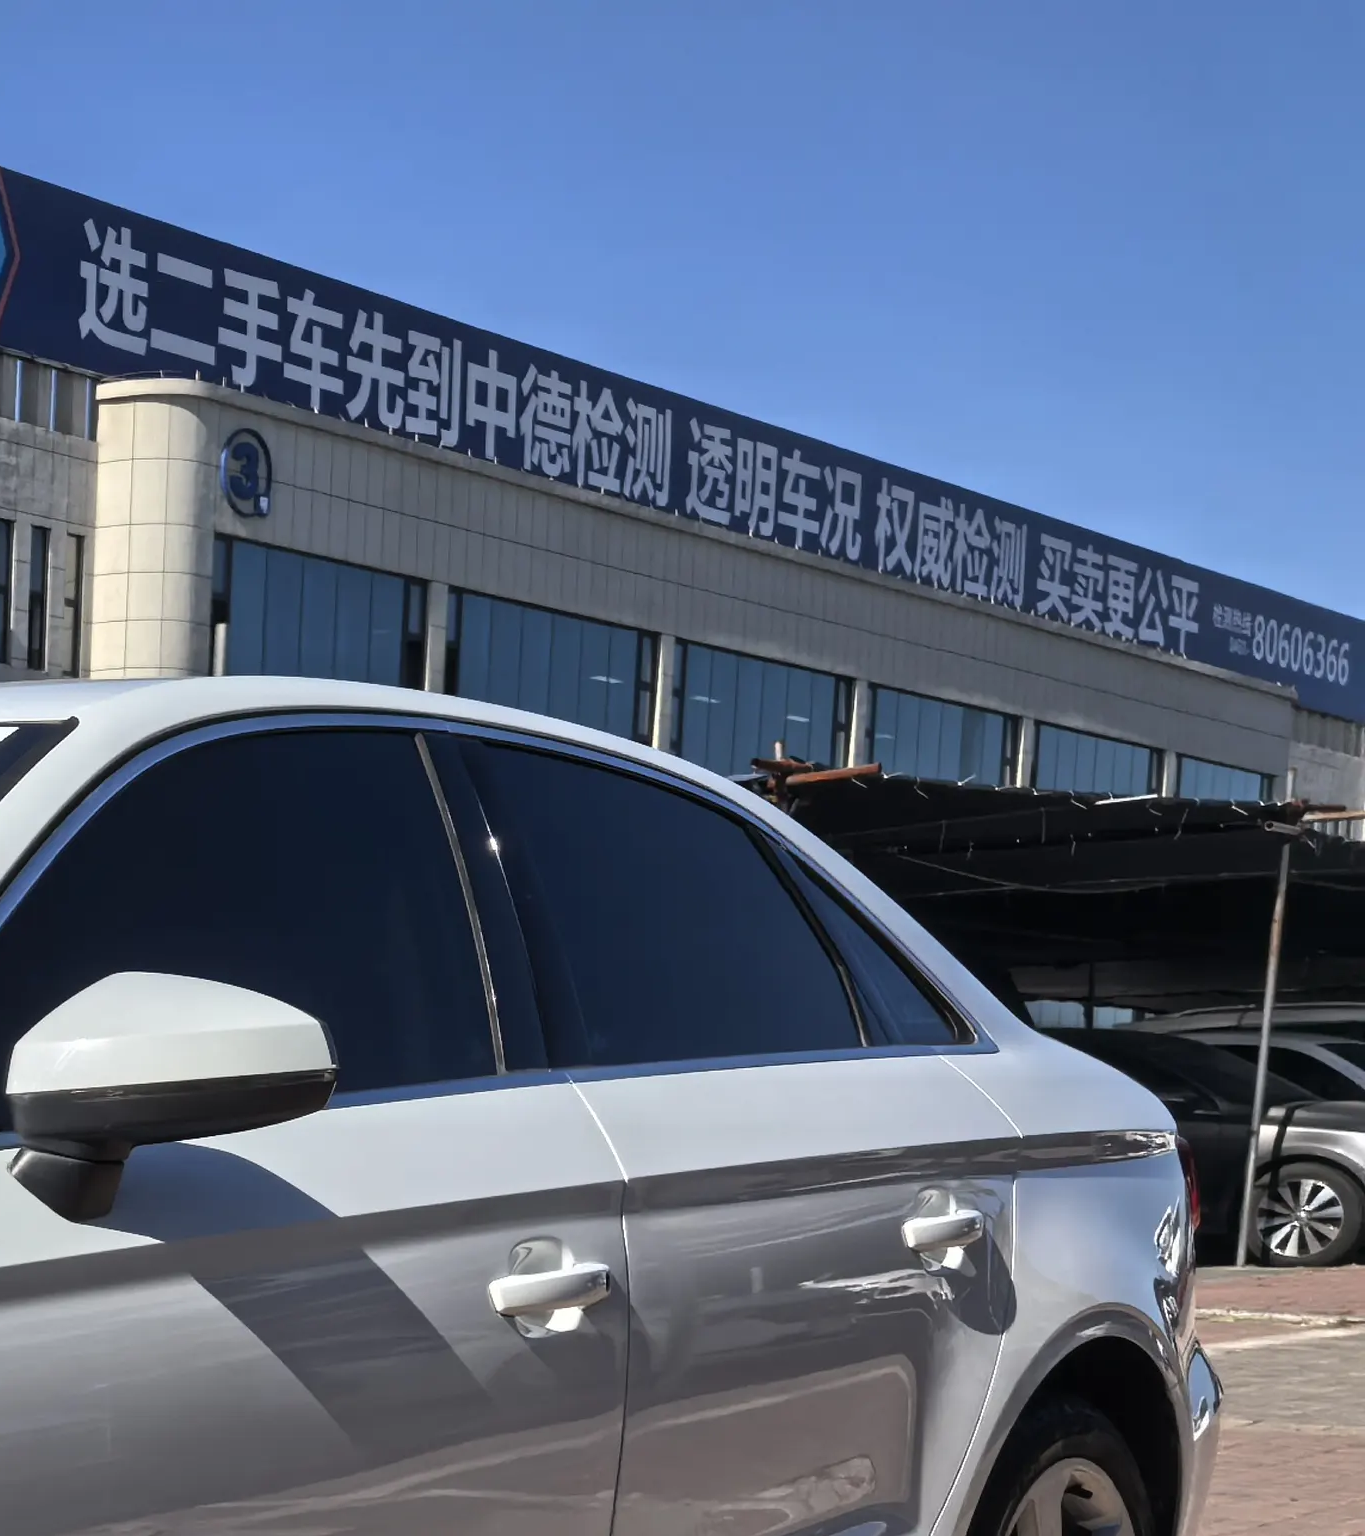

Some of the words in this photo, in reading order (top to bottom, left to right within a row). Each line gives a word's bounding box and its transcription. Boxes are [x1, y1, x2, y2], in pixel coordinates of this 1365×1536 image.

[79, 218, 672, 508] 选二手车先到中德检测
[685, 417, 862, 561] 透明车况
[873, 477, 1028, 608] 权威检测
[1036, 533, 1200, 658] 买卖更公平
[229, 441, 259, 501] 3
[1252, 614, 1350, 686] 80606366
